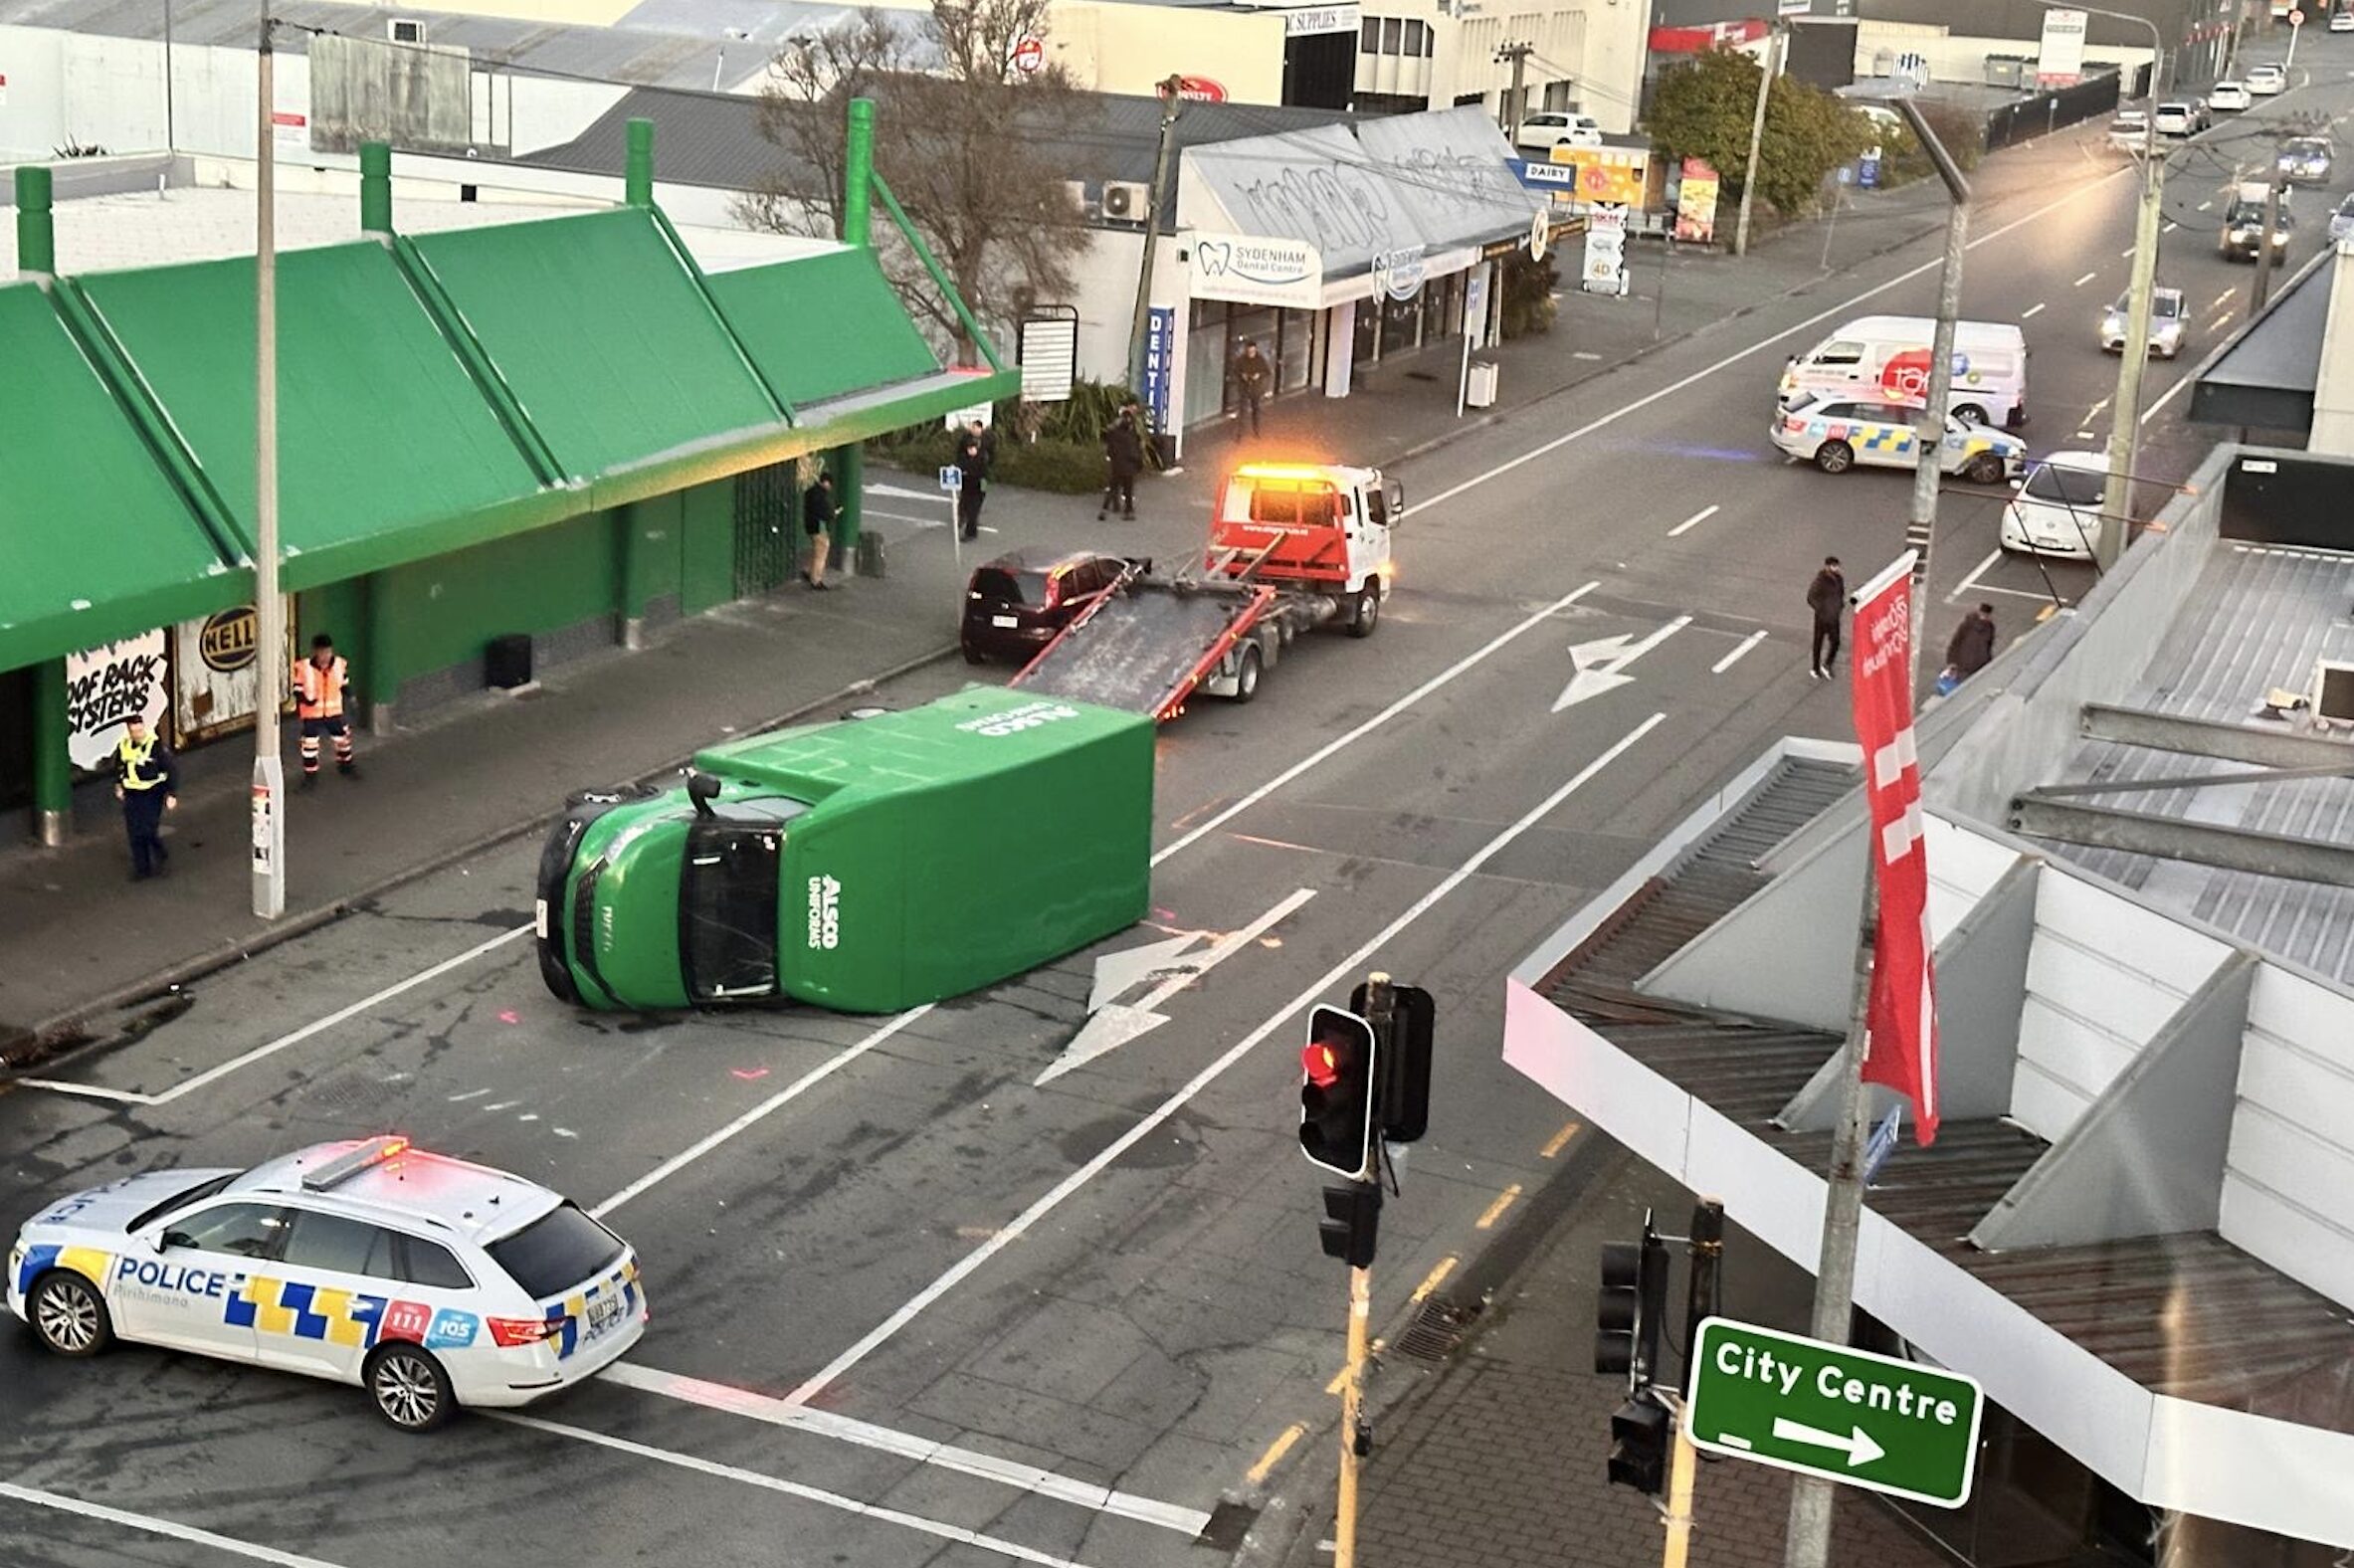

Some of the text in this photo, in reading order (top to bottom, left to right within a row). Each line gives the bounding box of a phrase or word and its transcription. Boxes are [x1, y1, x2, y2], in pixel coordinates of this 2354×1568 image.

[1296, 10, 1336, 31] SUPPLIES
[1530, 165, 1567, 179] DAIRY
[1236, 247, 1306, 266] SYDENHAM
[1237, 260, 1304, 274] Dental Centre
[102, 655, 158, 692] RACK
[808, 877, 822, 950] UNIFORMS
[821, 874, 841, 949] ALSCO
[117, 1258, 226, 1297] POLICE
[392, 1312, 423, 1331] 111
[438, 1319, 471, 1338] 105
[1716, 1342, 1957, 1426] City Centre
